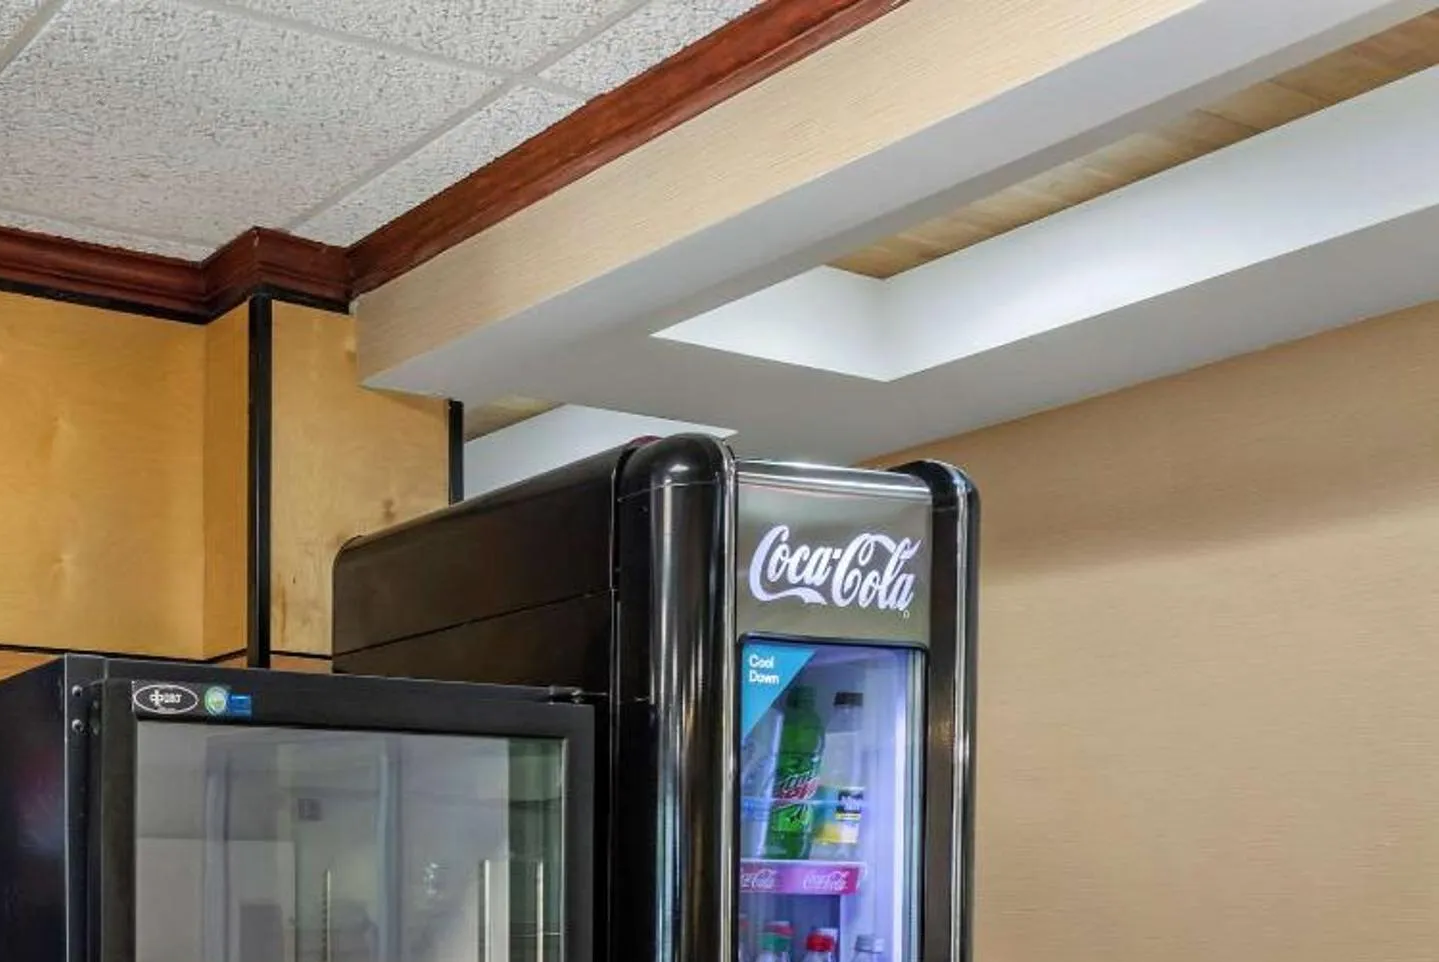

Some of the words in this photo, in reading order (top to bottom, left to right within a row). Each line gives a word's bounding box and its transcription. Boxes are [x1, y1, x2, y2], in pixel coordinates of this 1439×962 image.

[749, 524, 921, 613] Coca-Cola
[749, 654, 775, 669] Cool
[749, 669, 780, 685] Down
